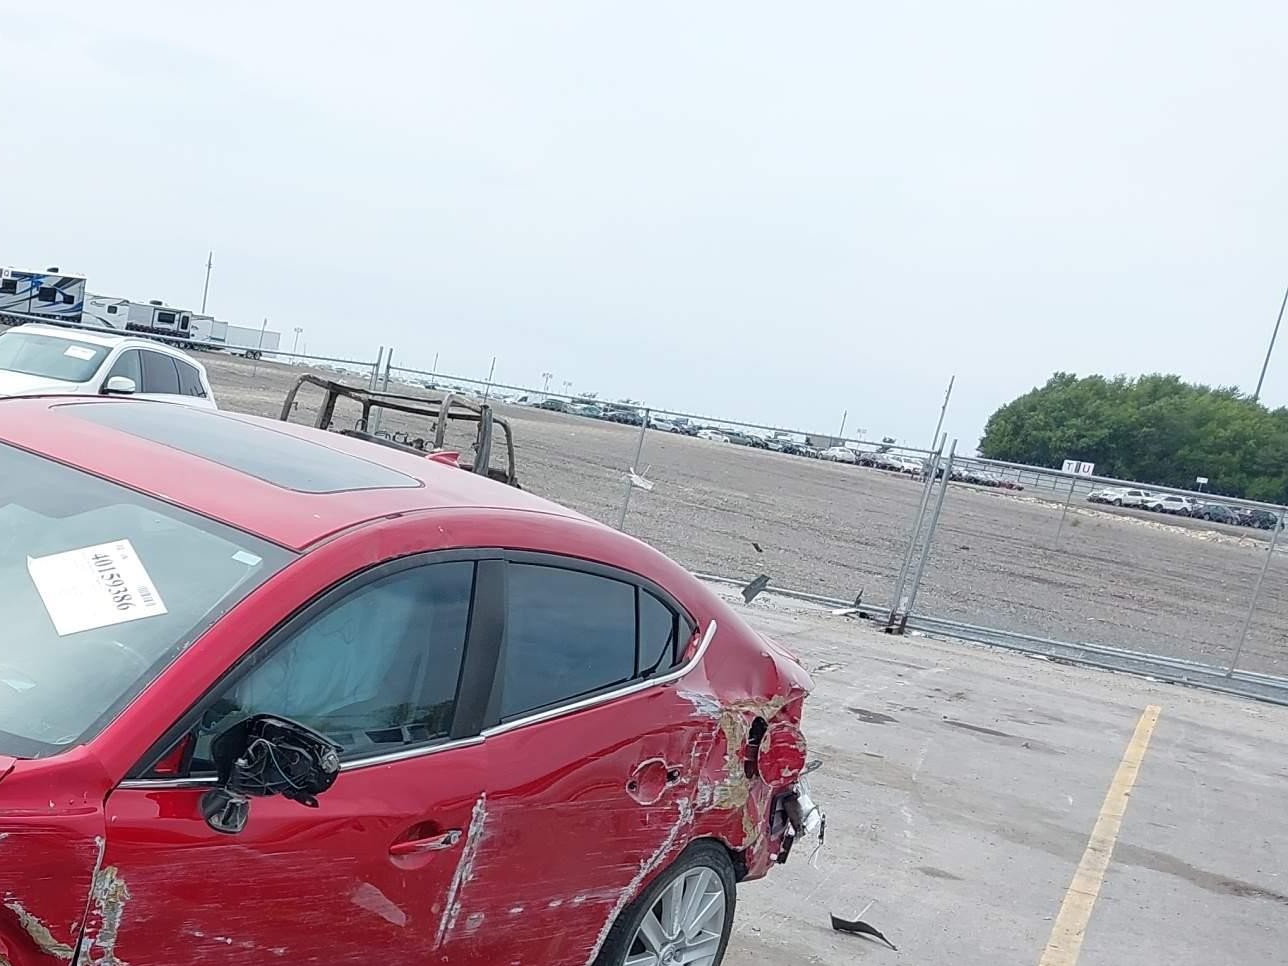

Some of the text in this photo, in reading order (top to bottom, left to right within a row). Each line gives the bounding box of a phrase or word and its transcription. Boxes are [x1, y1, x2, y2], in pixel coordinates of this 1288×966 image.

[1066, 462, 1075, 471] T
[1082, 464, 1091, 474] U
[90, 553, 137, 611] 40159386
